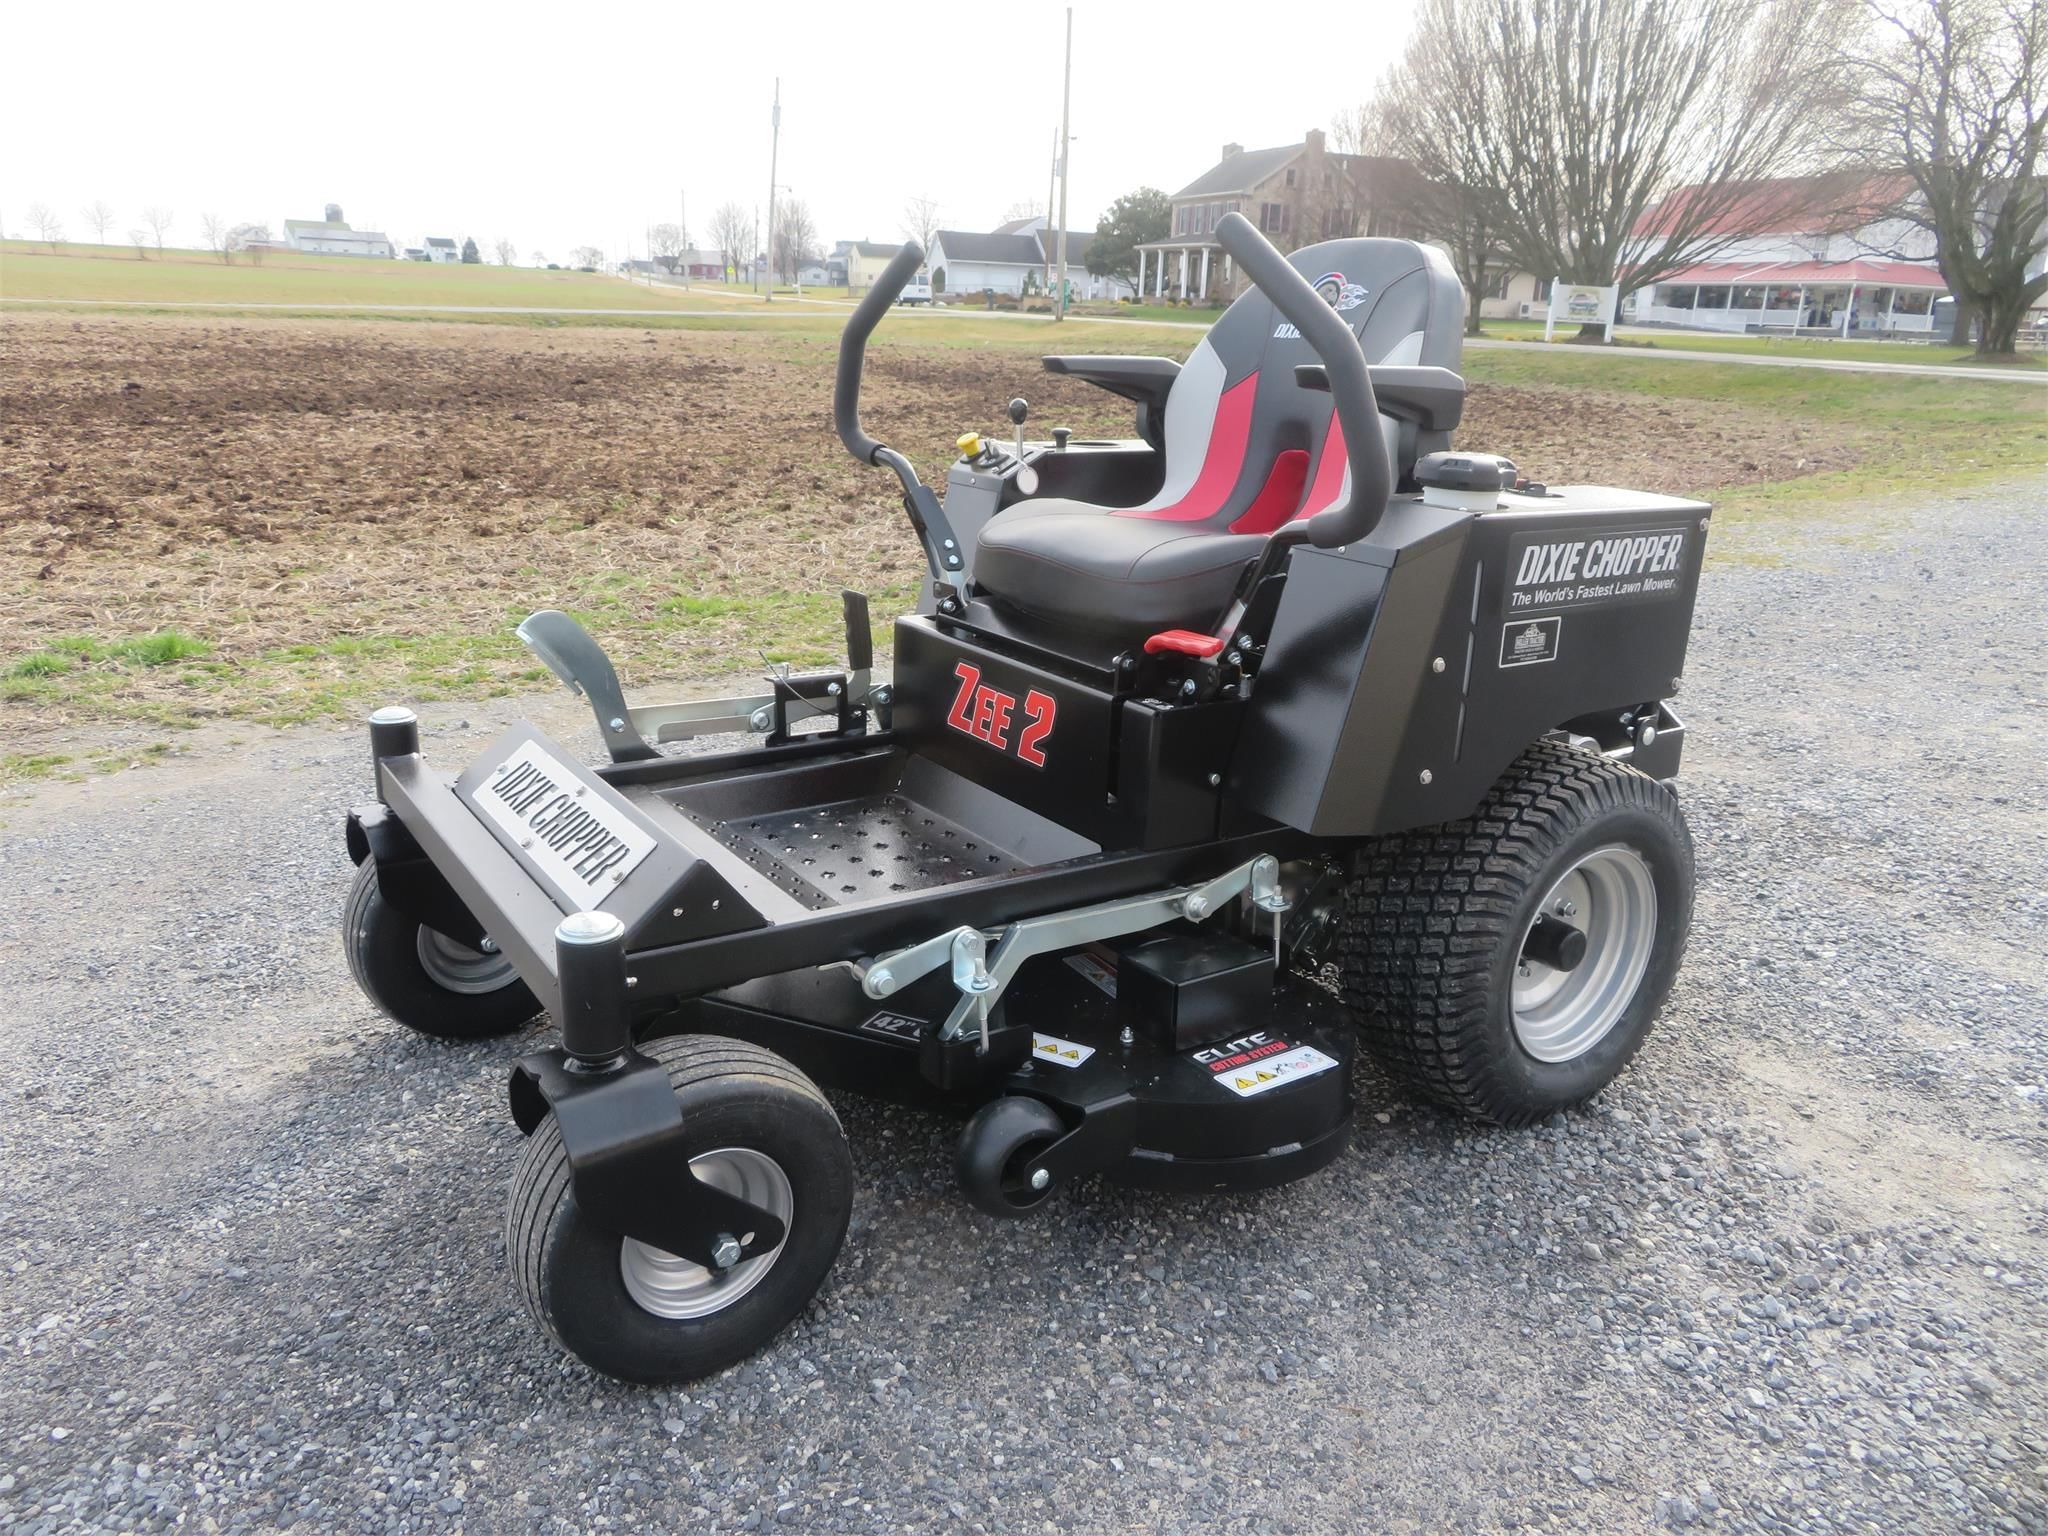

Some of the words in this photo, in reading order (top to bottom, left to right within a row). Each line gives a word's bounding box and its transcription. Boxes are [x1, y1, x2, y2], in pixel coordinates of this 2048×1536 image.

[1514, 541, 1586, 586] DIXIE
[1581, 534, 1684, 579] CHOPPER
[1511, 591, 1532, 606] The
[1534, 586, 1574, 603] World's
[1576, 583, 1613, 600] Fastest
[1614, 582, 1641, 595] Lawn
[1642, 577, 1675, 591] Mower
[947, 661, 1015, 750] ZEE
[1017, 688, 1056, 768] 2
[491, 760, 559, 818] DIXIE
[528, 793, 631, 887] CHOPPER
[1192, 1031, 1274, 1064] ELITE
[1208, 1053, 1250, 1072] CUTTING
[1247, 1041, 1289, 1060] SYSTEM
